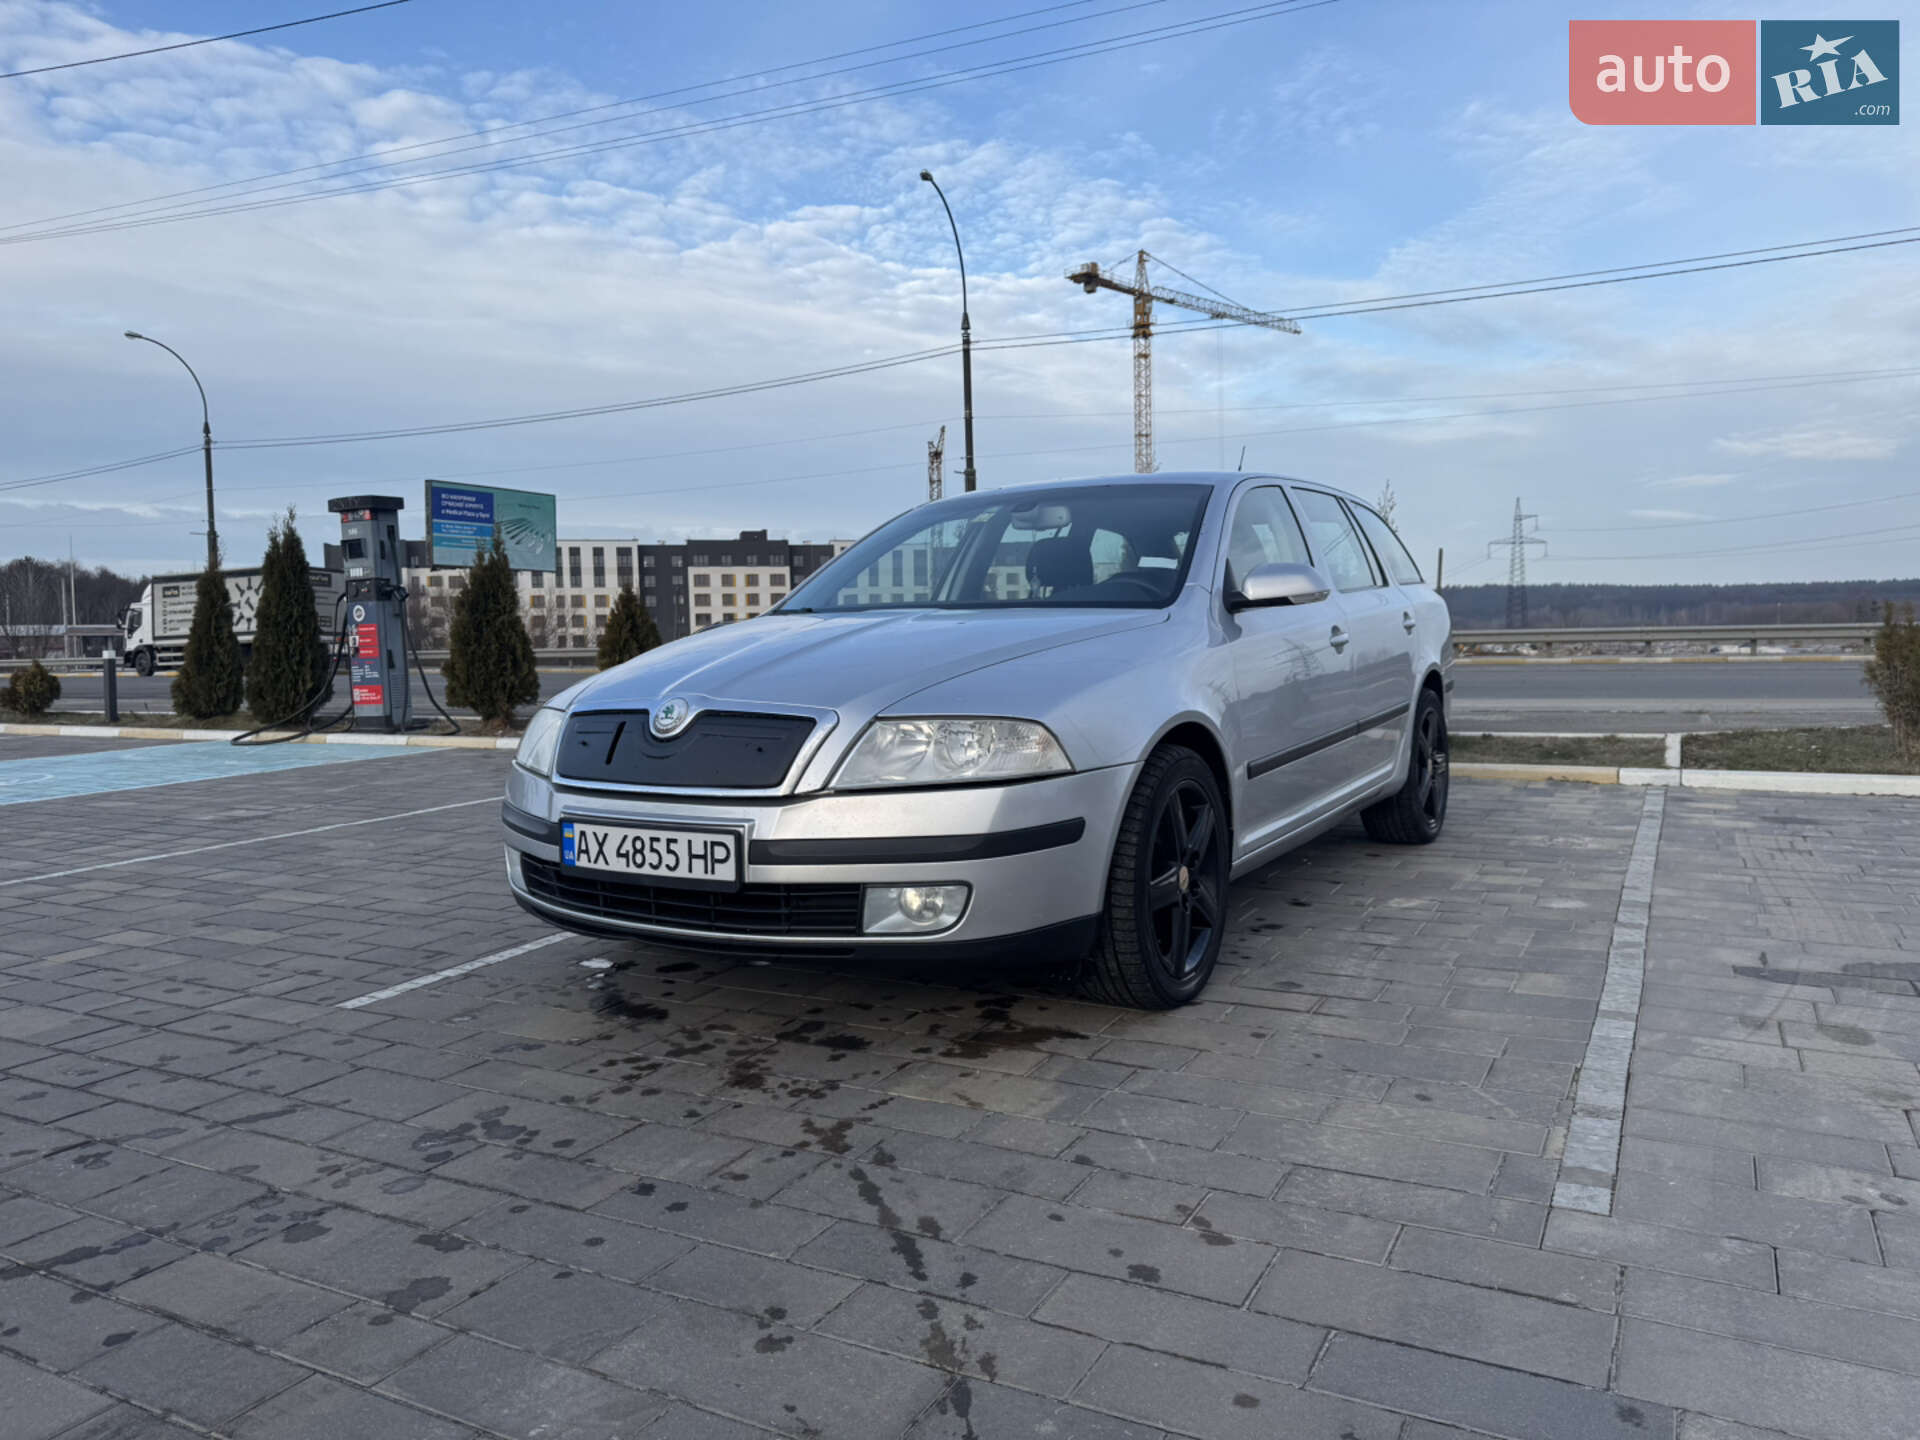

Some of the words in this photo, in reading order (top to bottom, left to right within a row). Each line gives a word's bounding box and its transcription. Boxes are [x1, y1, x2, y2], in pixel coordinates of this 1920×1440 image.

[577, 831, 609, 865] AX
[616, 834, 681, 872] 4855
[688, 839, 731, 875] HP
